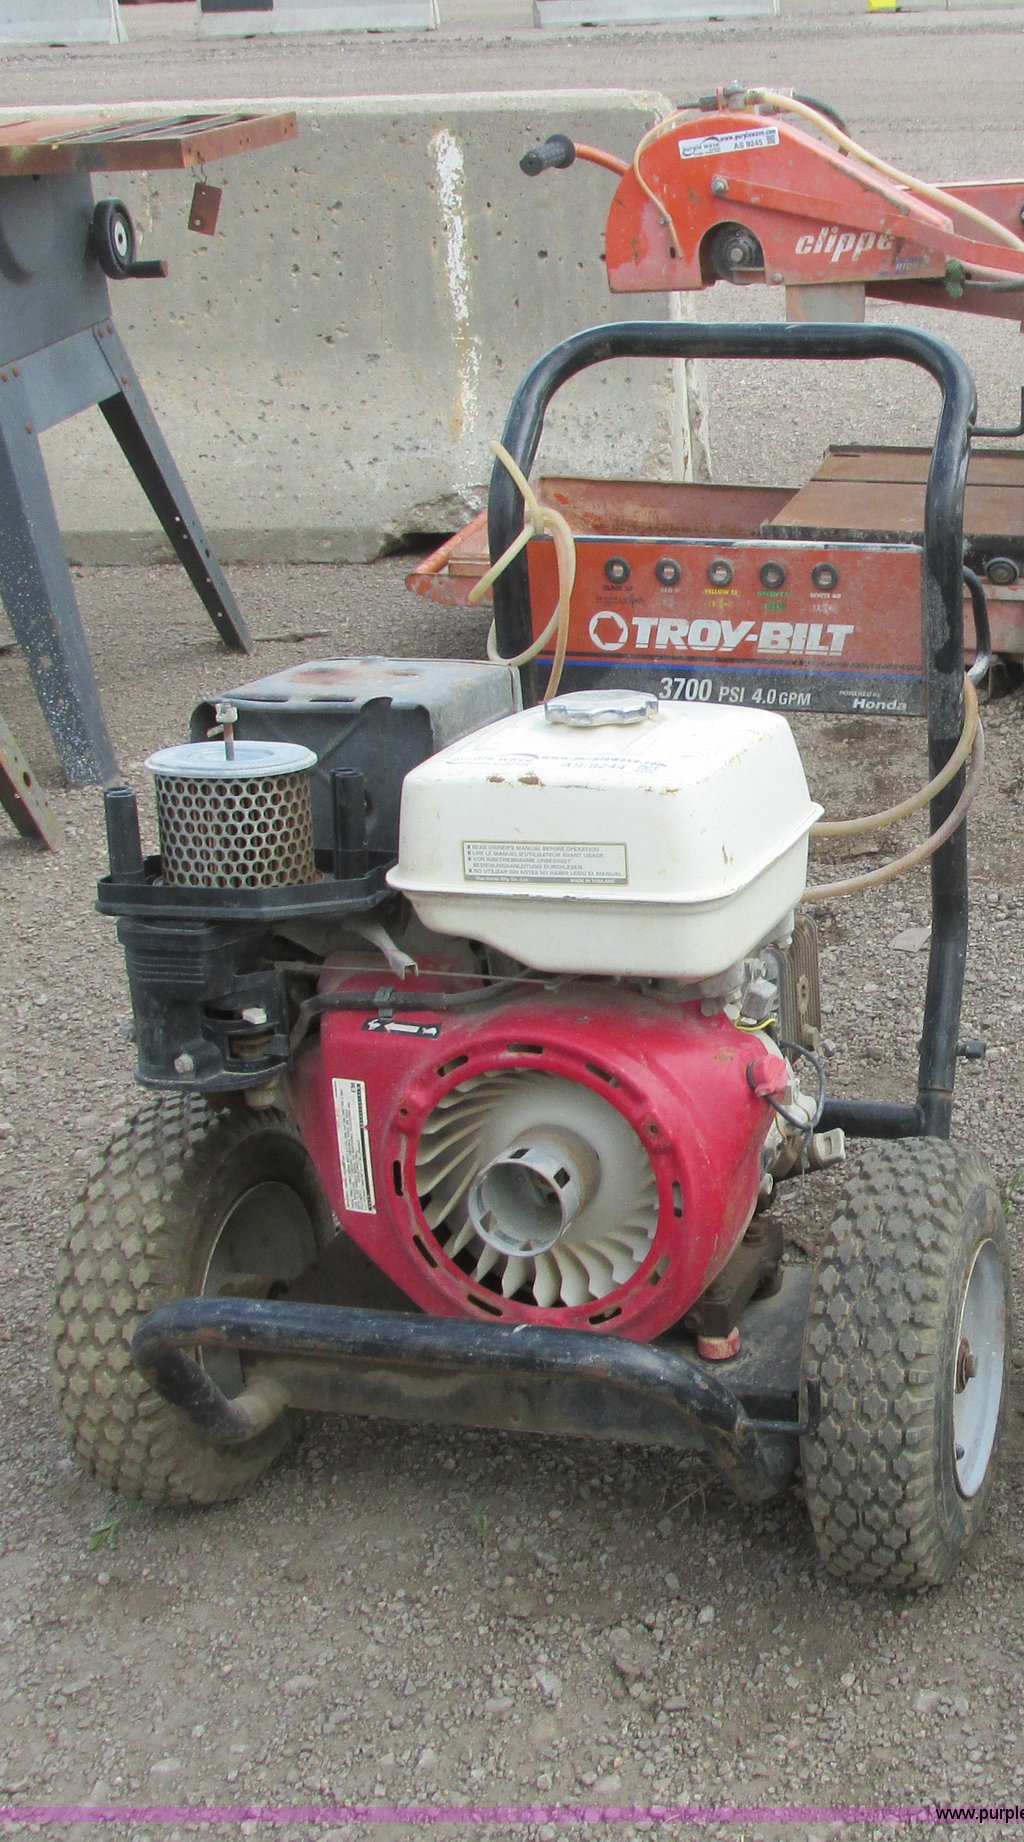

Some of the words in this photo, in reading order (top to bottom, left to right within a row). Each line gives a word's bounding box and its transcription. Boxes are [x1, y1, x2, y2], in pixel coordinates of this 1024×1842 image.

[631, 617, 855, 656] TROY-BILT
[659, 677, 713, 702] 3700
[718, 686, 745, 703] PSI
[751, 687, 777, 704] 4.0
[779, 692, 812, 706] GPM
[853, 698, 907, 712] Honda
